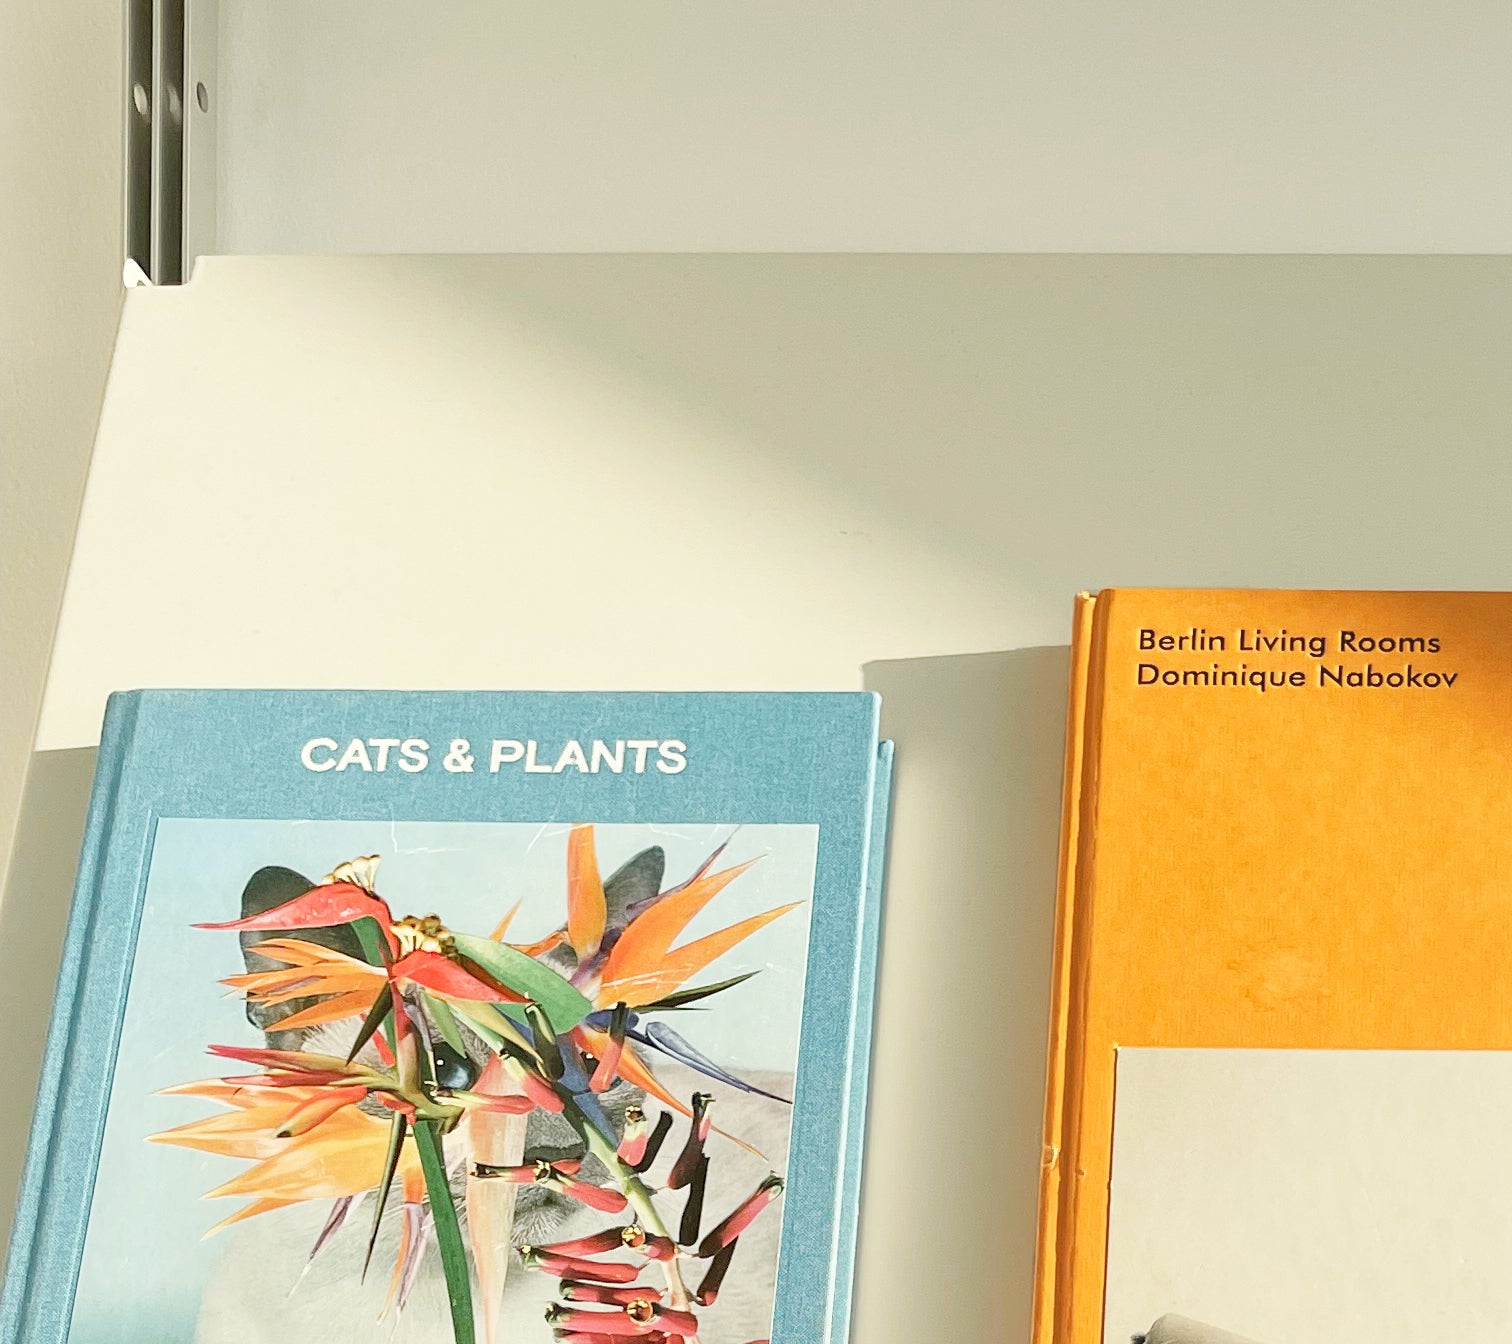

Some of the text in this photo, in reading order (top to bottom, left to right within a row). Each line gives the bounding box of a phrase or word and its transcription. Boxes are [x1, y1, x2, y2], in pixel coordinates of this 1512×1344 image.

[1138, 628, 1442, 658] Berlin Living Rooms
[1138, 663, 1459, 692] Dominique Nabokov
[300, 737, 689, 775] CATS & PLANTS
